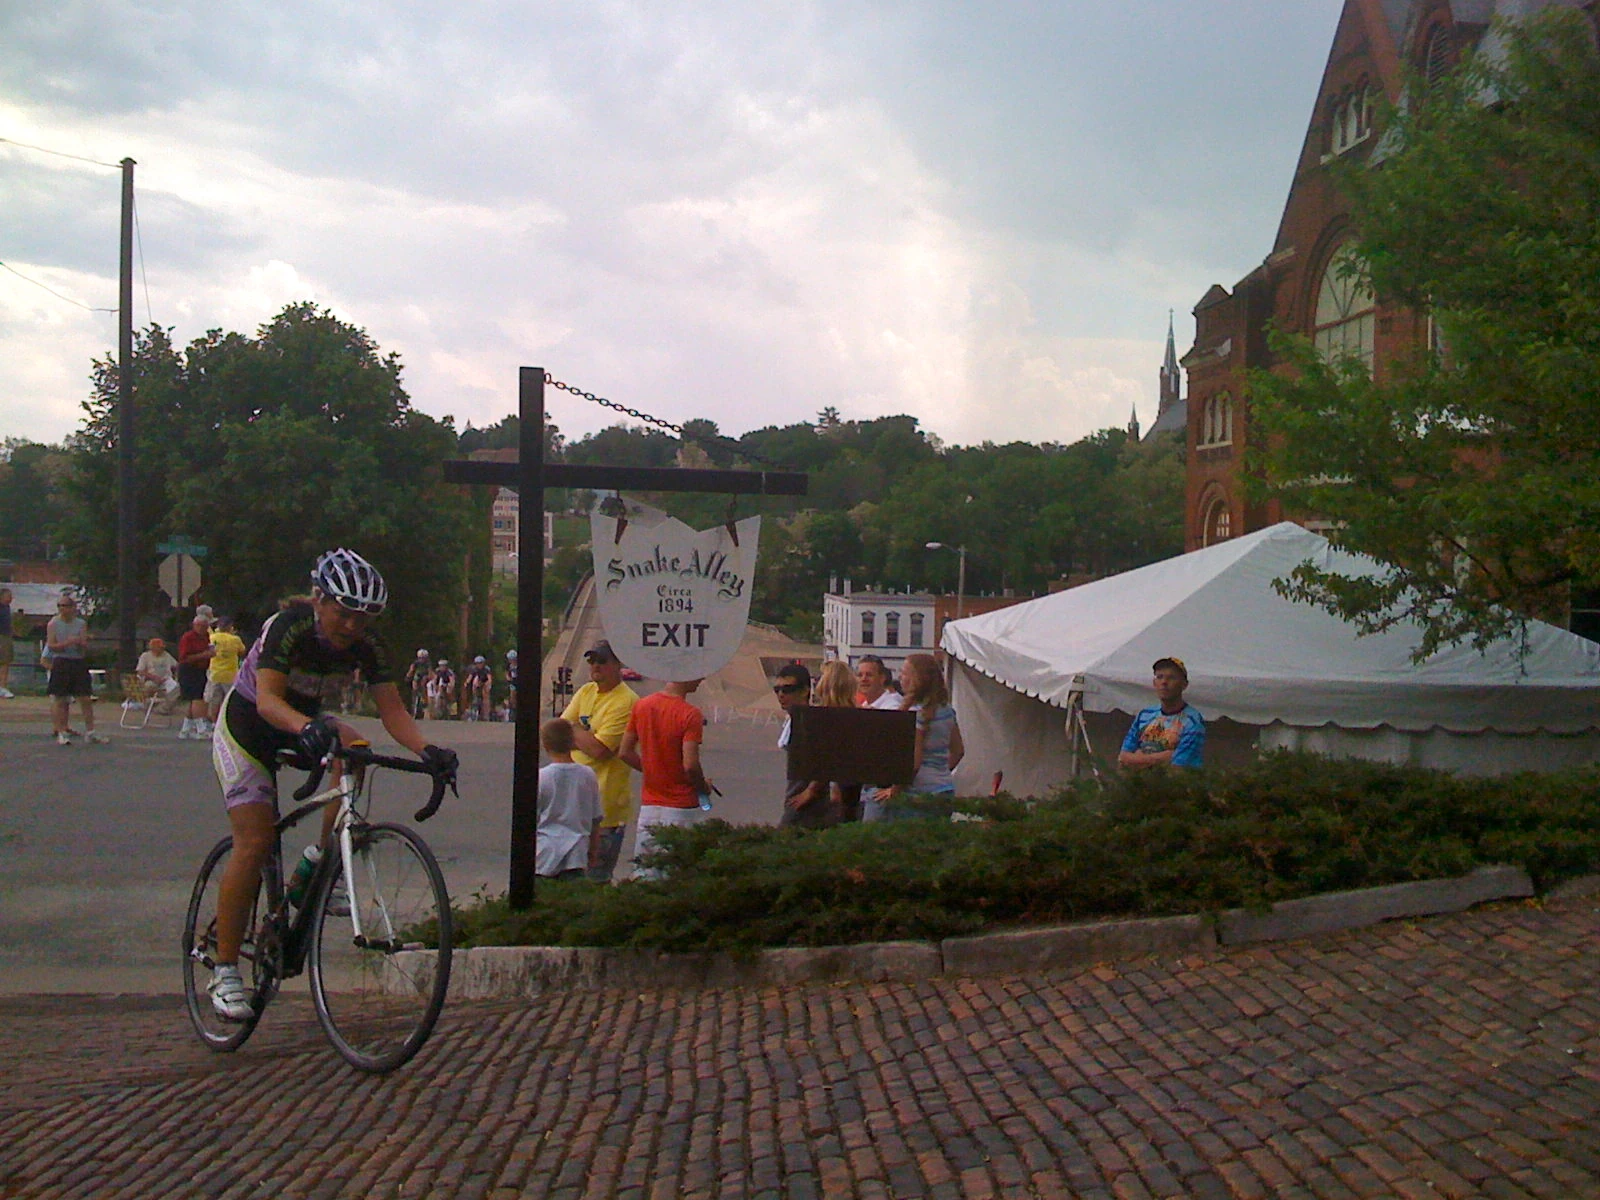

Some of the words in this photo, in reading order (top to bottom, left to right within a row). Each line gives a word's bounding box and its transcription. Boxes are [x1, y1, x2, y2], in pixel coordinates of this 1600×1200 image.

[606, 545, 680, 591] Snake
[680, 547, 745, 599] Alley
[656, 584, 692, 596] Circa
[659, 598, 694, 613] 1894
[642, 622, 710, 648] EXIT
